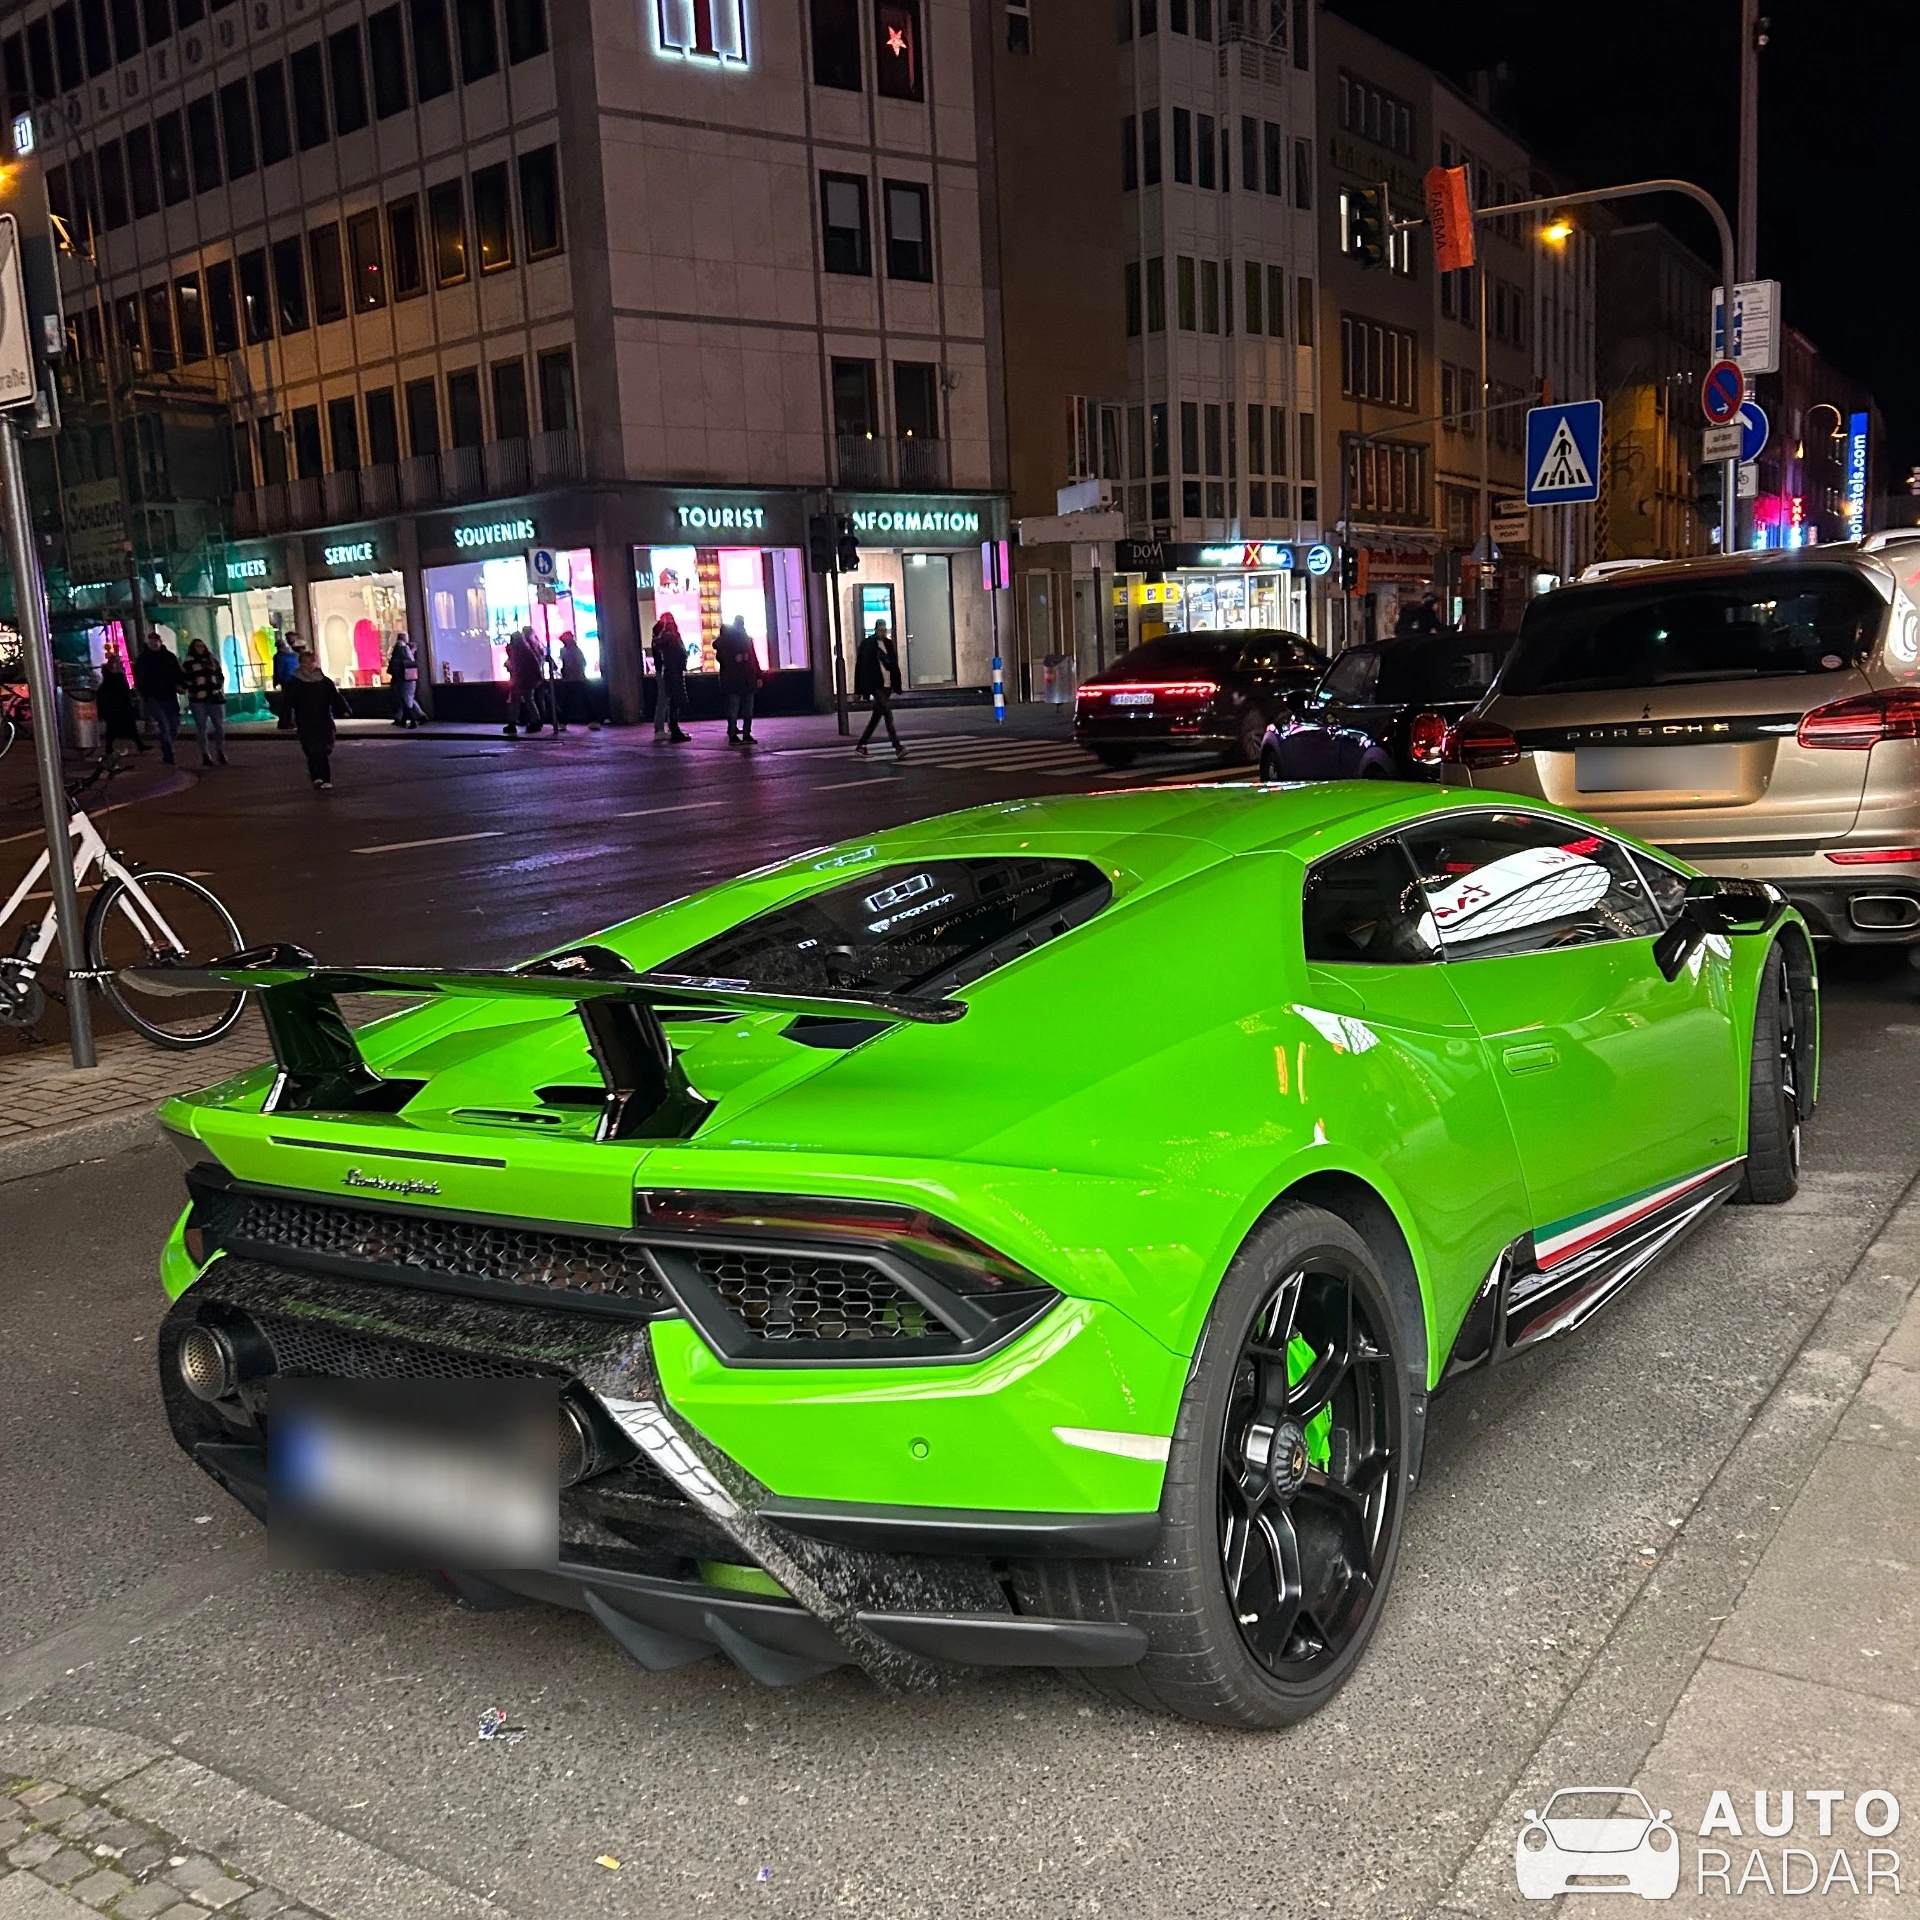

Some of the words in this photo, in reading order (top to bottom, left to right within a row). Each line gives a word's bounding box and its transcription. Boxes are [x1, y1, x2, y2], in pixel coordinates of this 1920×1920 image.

[1431, 191, 1446, 250] FABEMA
[677, 506, 764, 528] TOURIST
[852, 511, 979, 531] NFORMATION
[454, 519, 535, 547] SOUVENIRS
[325, 543, 373, 565] SERVICE
[1132, 541, 1165, 569] DOM
[225, 559, 267, 578] TICKETS
[1567, 723, 1729, 739] PORSCHE
[341, 1169, 441, 1196] Lamborghini
